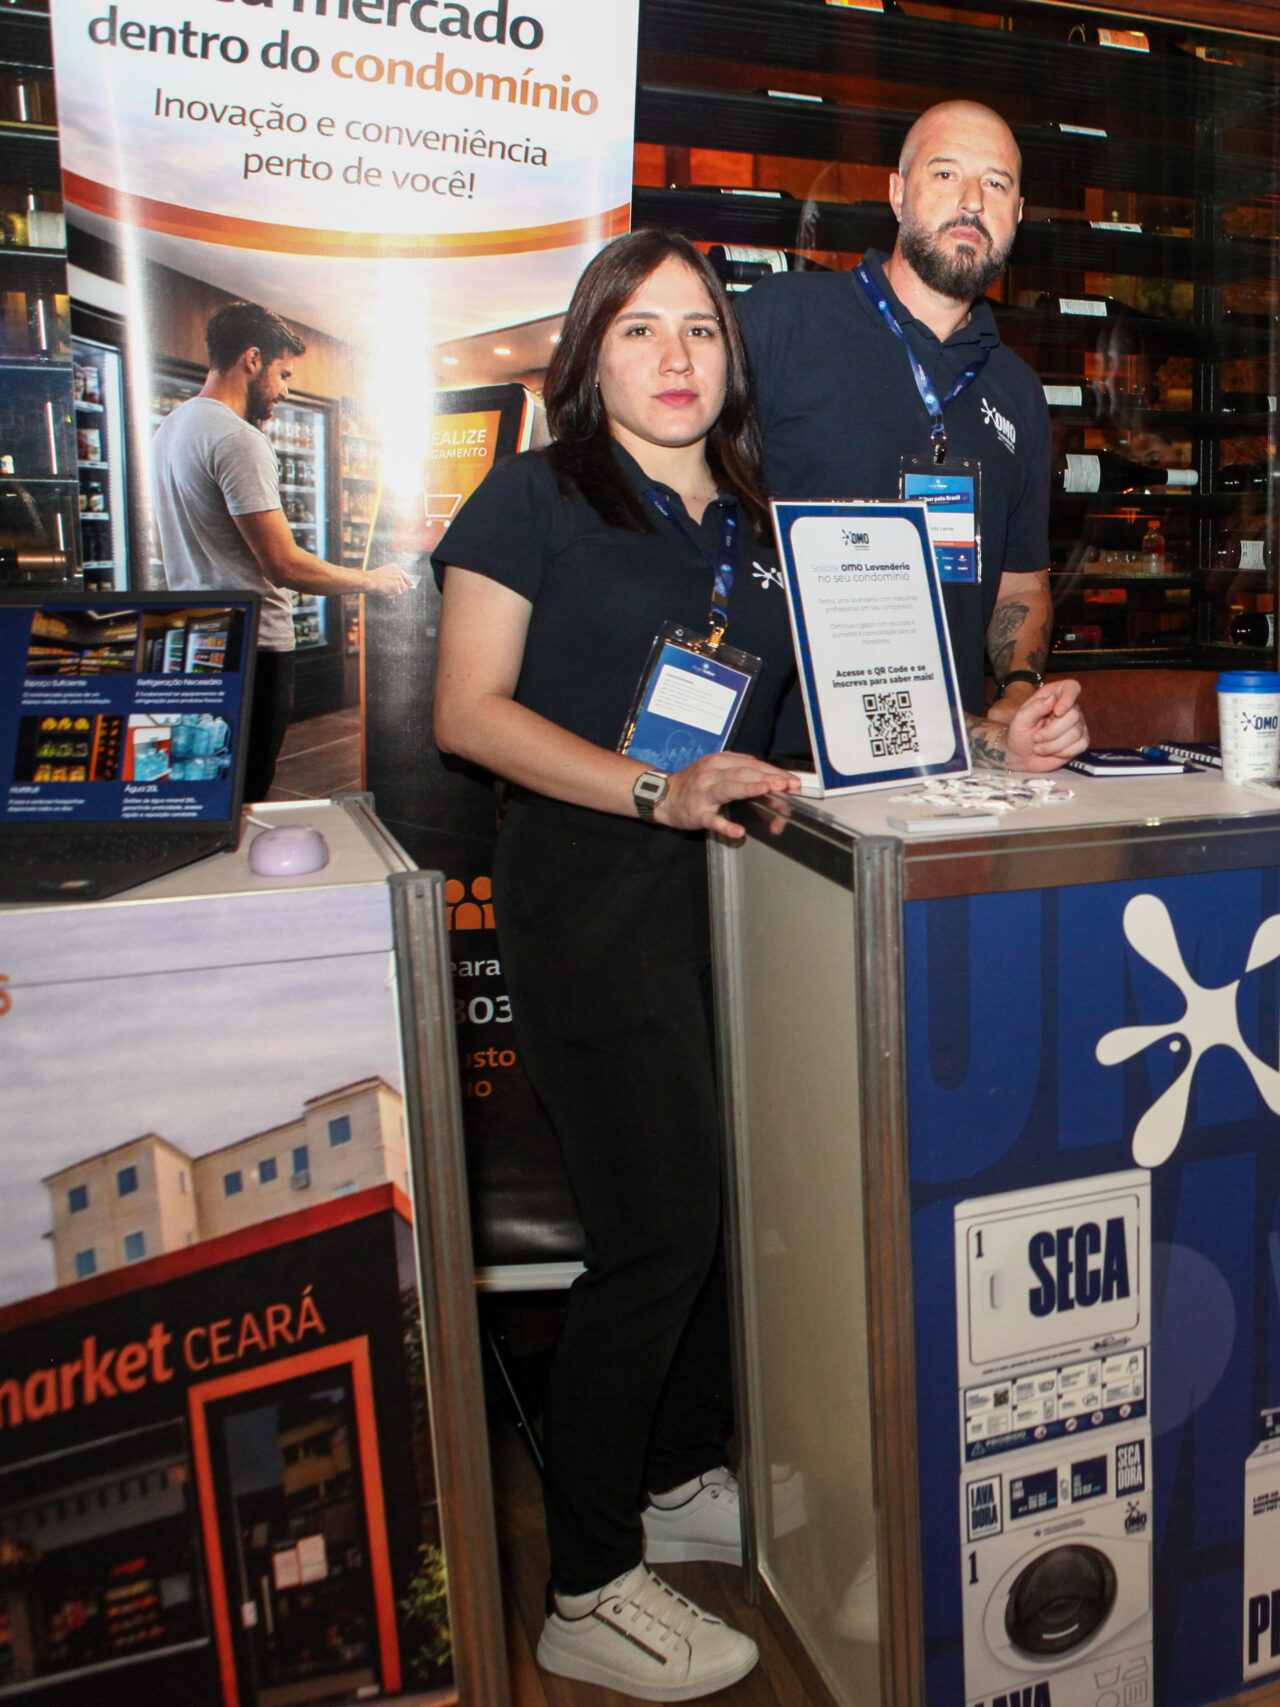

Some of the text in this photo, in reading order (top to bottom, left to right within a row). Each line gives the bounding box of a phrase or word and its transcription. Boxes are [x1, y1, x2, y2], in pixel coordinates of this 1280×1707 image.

[88, 4, 599, 116] dentro do condomínio
[154, 87, 548, 167] Inovação e conveniência
[243, 152, 476, 199] perto de você!
[431, 429, 488, 446] EALIZE
[995, 412, 1016, 444] OMO
[851, 532, 869, 544] OMO
[818, 571, 910, 583] no seu condomínio
[841, 563, 863, 572] OMO
[865, 561, 910, 571] Lavanderia
[832, 672, 935, 688] inscreva para saber mais!
[836, 668, 865, 678] Acesse
[874, 666, 886, 676] QR
[888, 664, 908, 674] Code
[1255, 715, 1279, 730] OMO
[463, 1047, 516, 1068] sto
[975, 1216, 1130, 1318] 1 SECA
[183, 1284, 326, 1373] CEARÁ
[1118, 1443, 1140, 1468] SECA
[968, 1551, 979, 1586] 1
